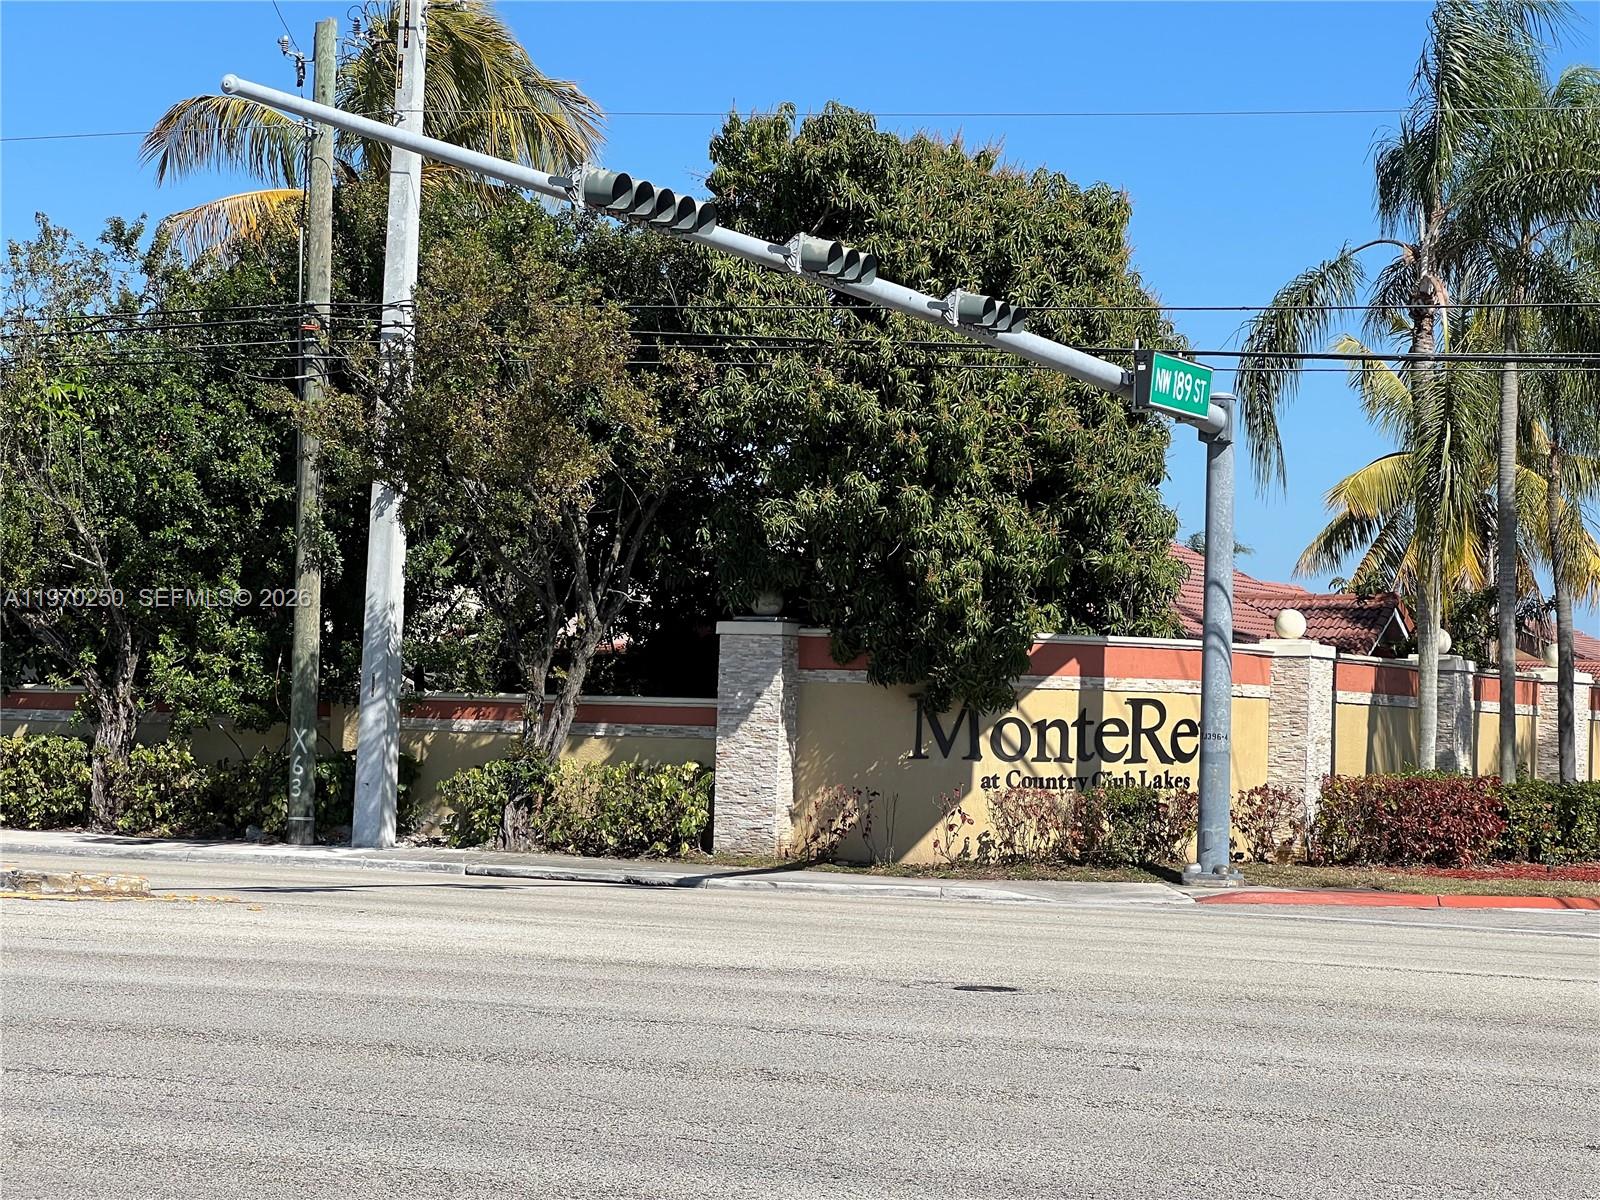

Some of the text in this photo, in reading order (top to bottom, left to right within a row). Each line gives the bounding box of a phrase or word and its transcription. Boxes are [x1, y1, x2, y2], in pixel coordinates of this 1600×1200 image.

[1155, 368, 1207, 404] NW 189 ST
[907, 692, 1201, 764] MonteRe
[980, 773, 1001, 790] at
[1005, 769, 1088, 793] Country
[1138, 769, 1191, 789] Lakes
